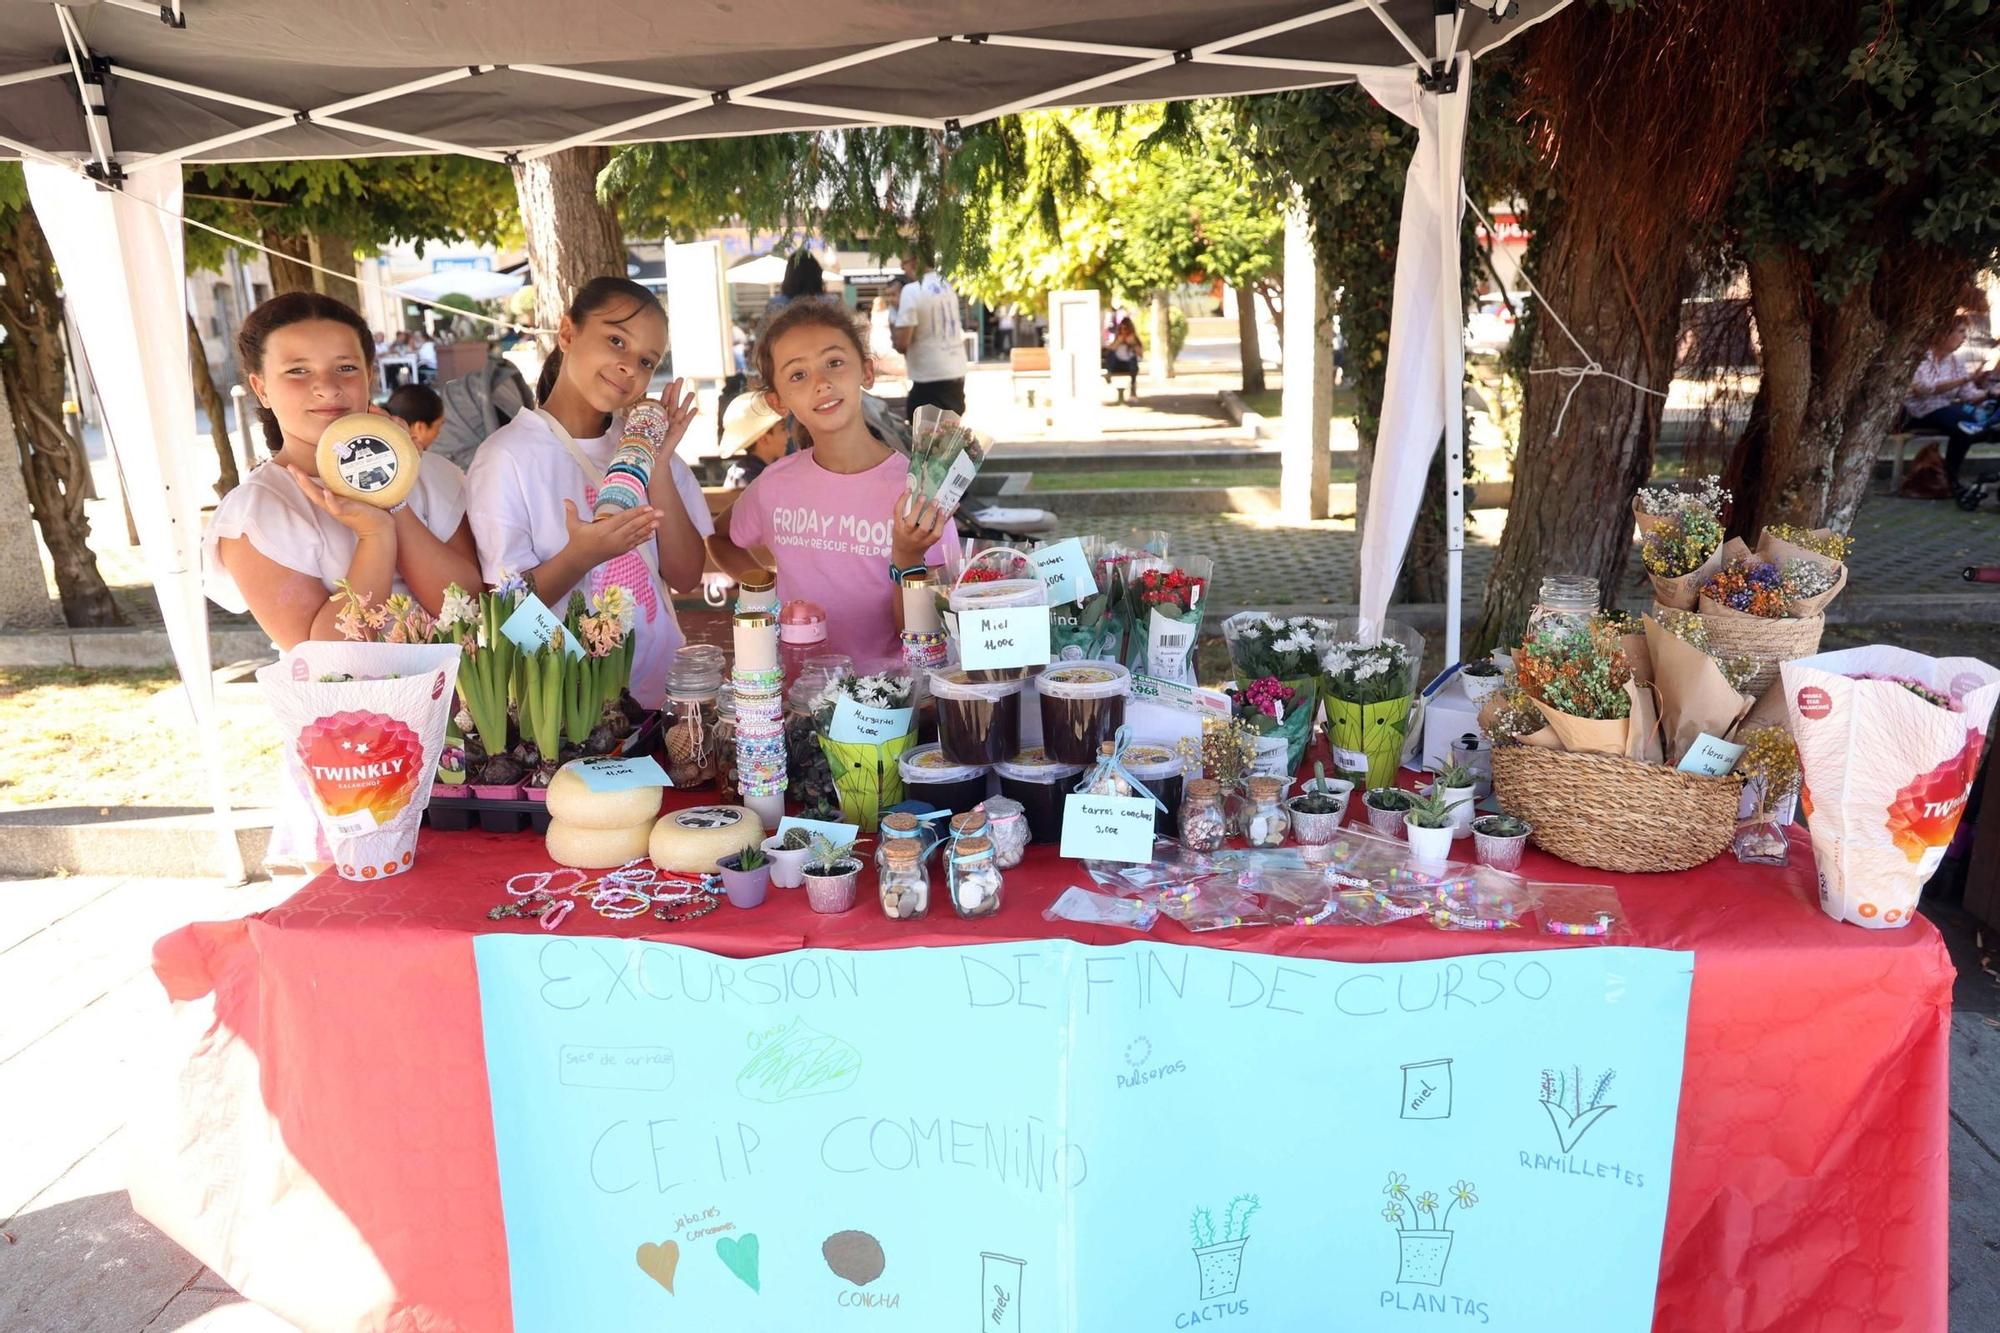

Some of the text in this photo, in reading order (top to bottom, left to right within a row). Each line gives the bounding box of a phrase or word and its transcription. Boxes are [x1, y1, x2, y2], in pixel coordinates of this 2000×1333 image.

[773, 507, 834, 537] FRIDAY
[774, 535, 881, 556] MONDAY RESCUE HELP
[981, 619, 1008, 632] Miel
[1050, 612, 1078, 626] lina
[312, 758, 403, 781] TWINKLY
[1081, 804, 1113, 816] tarros
[960, 952, 1048, 1009] DE
[1084, 949, 1189, 1015] FIN
[1227, 960, 1317, 1015] DE
[1334, 960, 1553, 1016] CURSO
[1410, 1079, 1438, 1111] miel
[837, 1290, 901, 1310] CONCHA
[991, 1284, 1011, 1326] miel
[1380, 1291, 1490, 1325] PLANTAS
[1174, 1299, 1250, 1330] CACTUS
